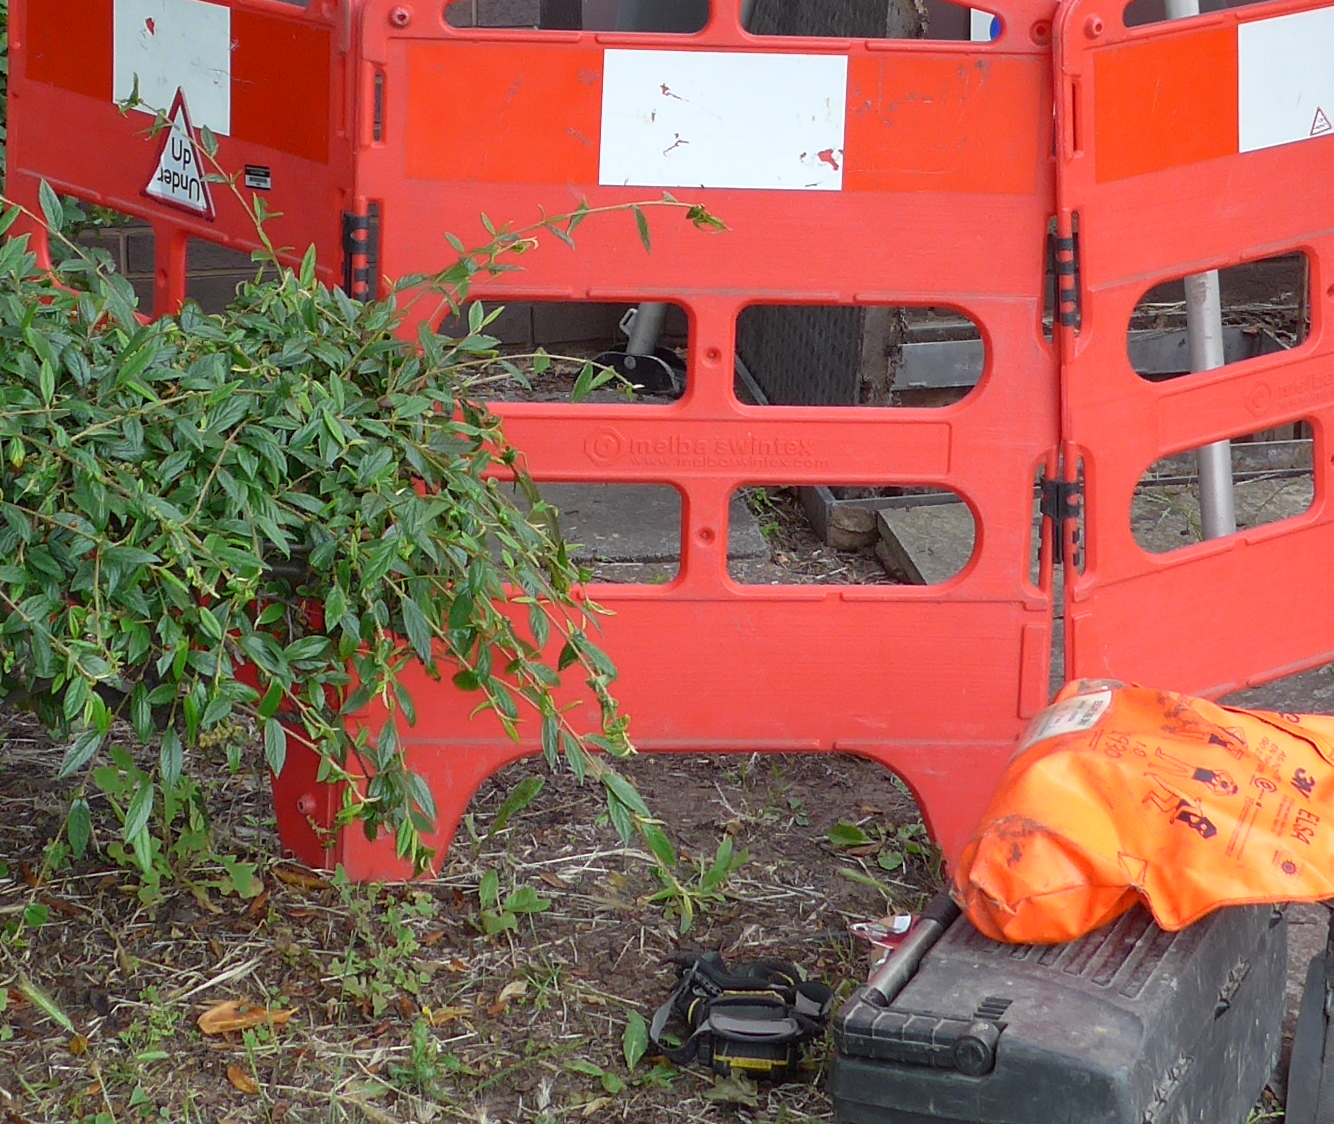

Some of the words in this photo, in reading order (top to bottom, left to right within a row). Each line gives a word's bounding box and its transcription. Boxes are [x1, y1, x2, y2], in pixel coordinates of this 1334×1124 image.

[171, 136, 192, 171] Up
[157, 167, 200, 202] Under
[629, 434, 707, 456] melba
[715, 434, 813, 457] swintex
